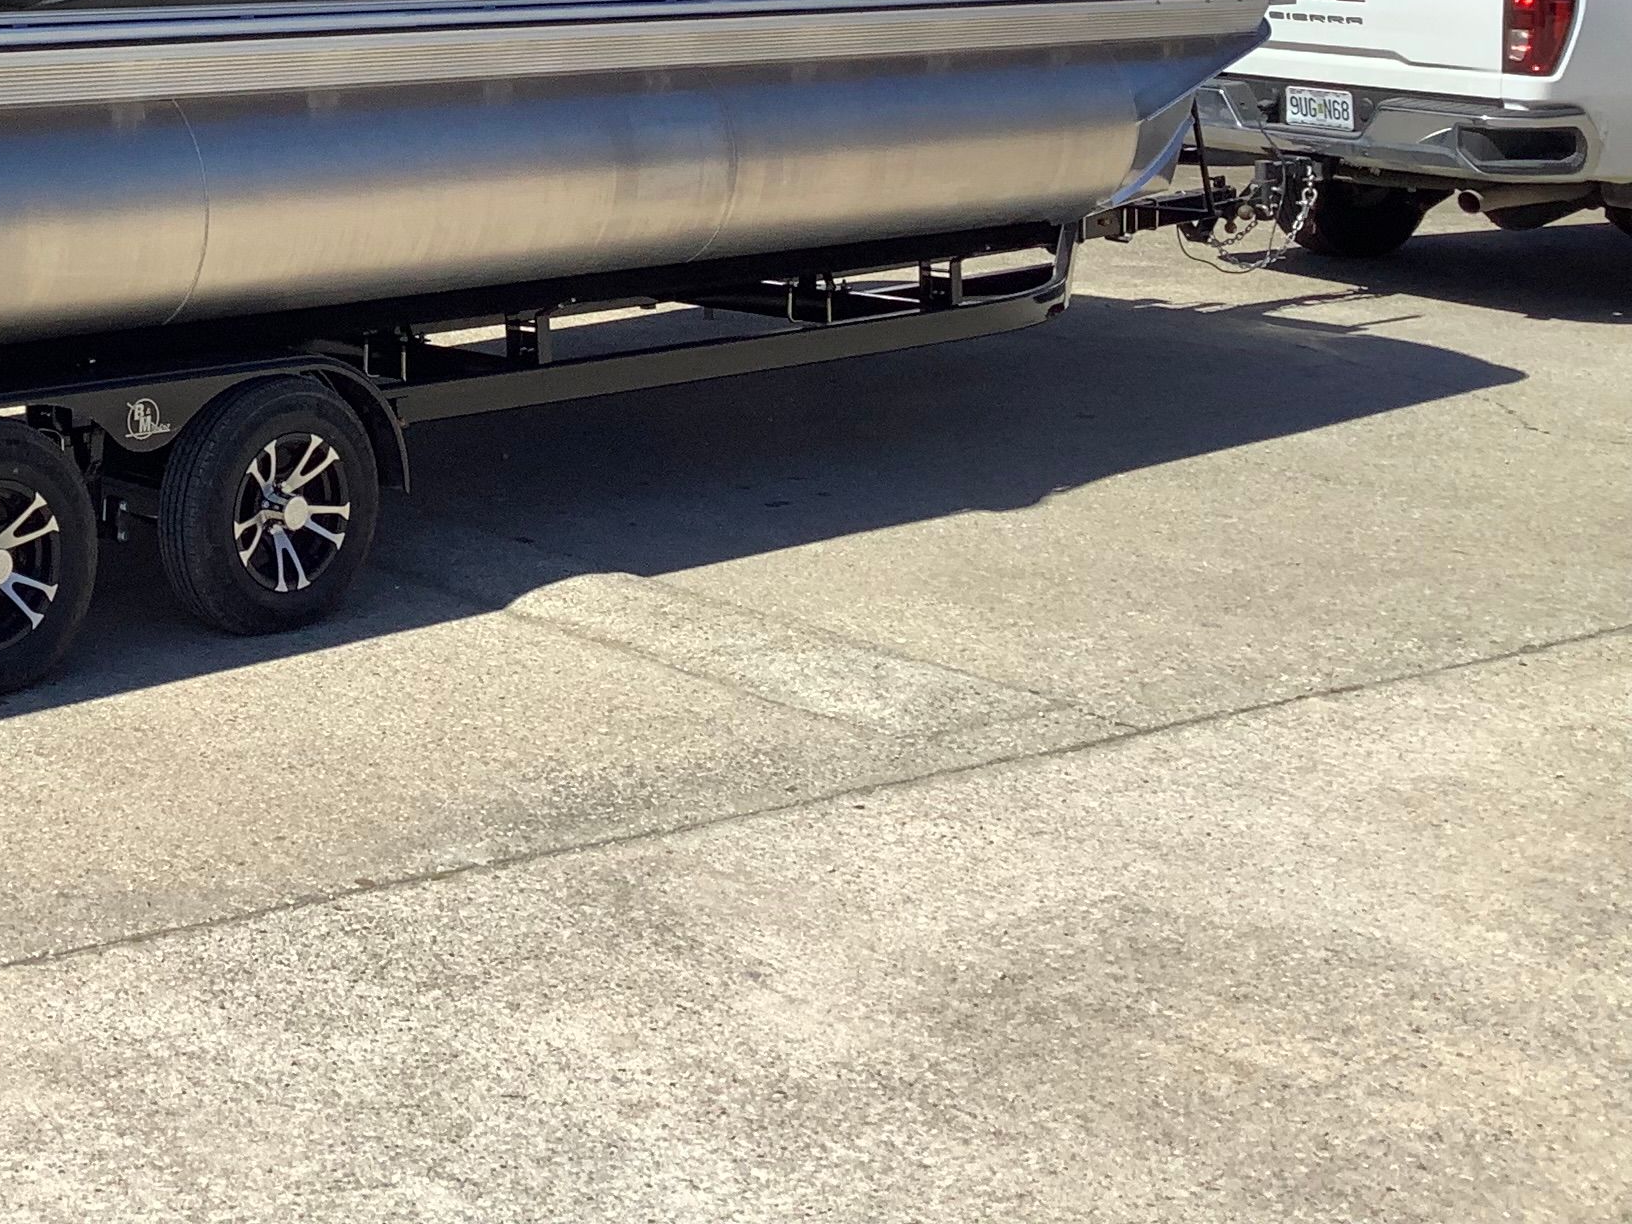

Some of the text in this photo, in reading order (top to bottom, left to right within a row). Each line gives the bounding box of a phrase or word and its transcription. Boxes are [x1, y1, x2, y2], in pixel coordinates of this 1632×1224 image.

[1269, 10, 1364, 25] SIERRA
[1290, 95, 1350, 121] 9UG N68
